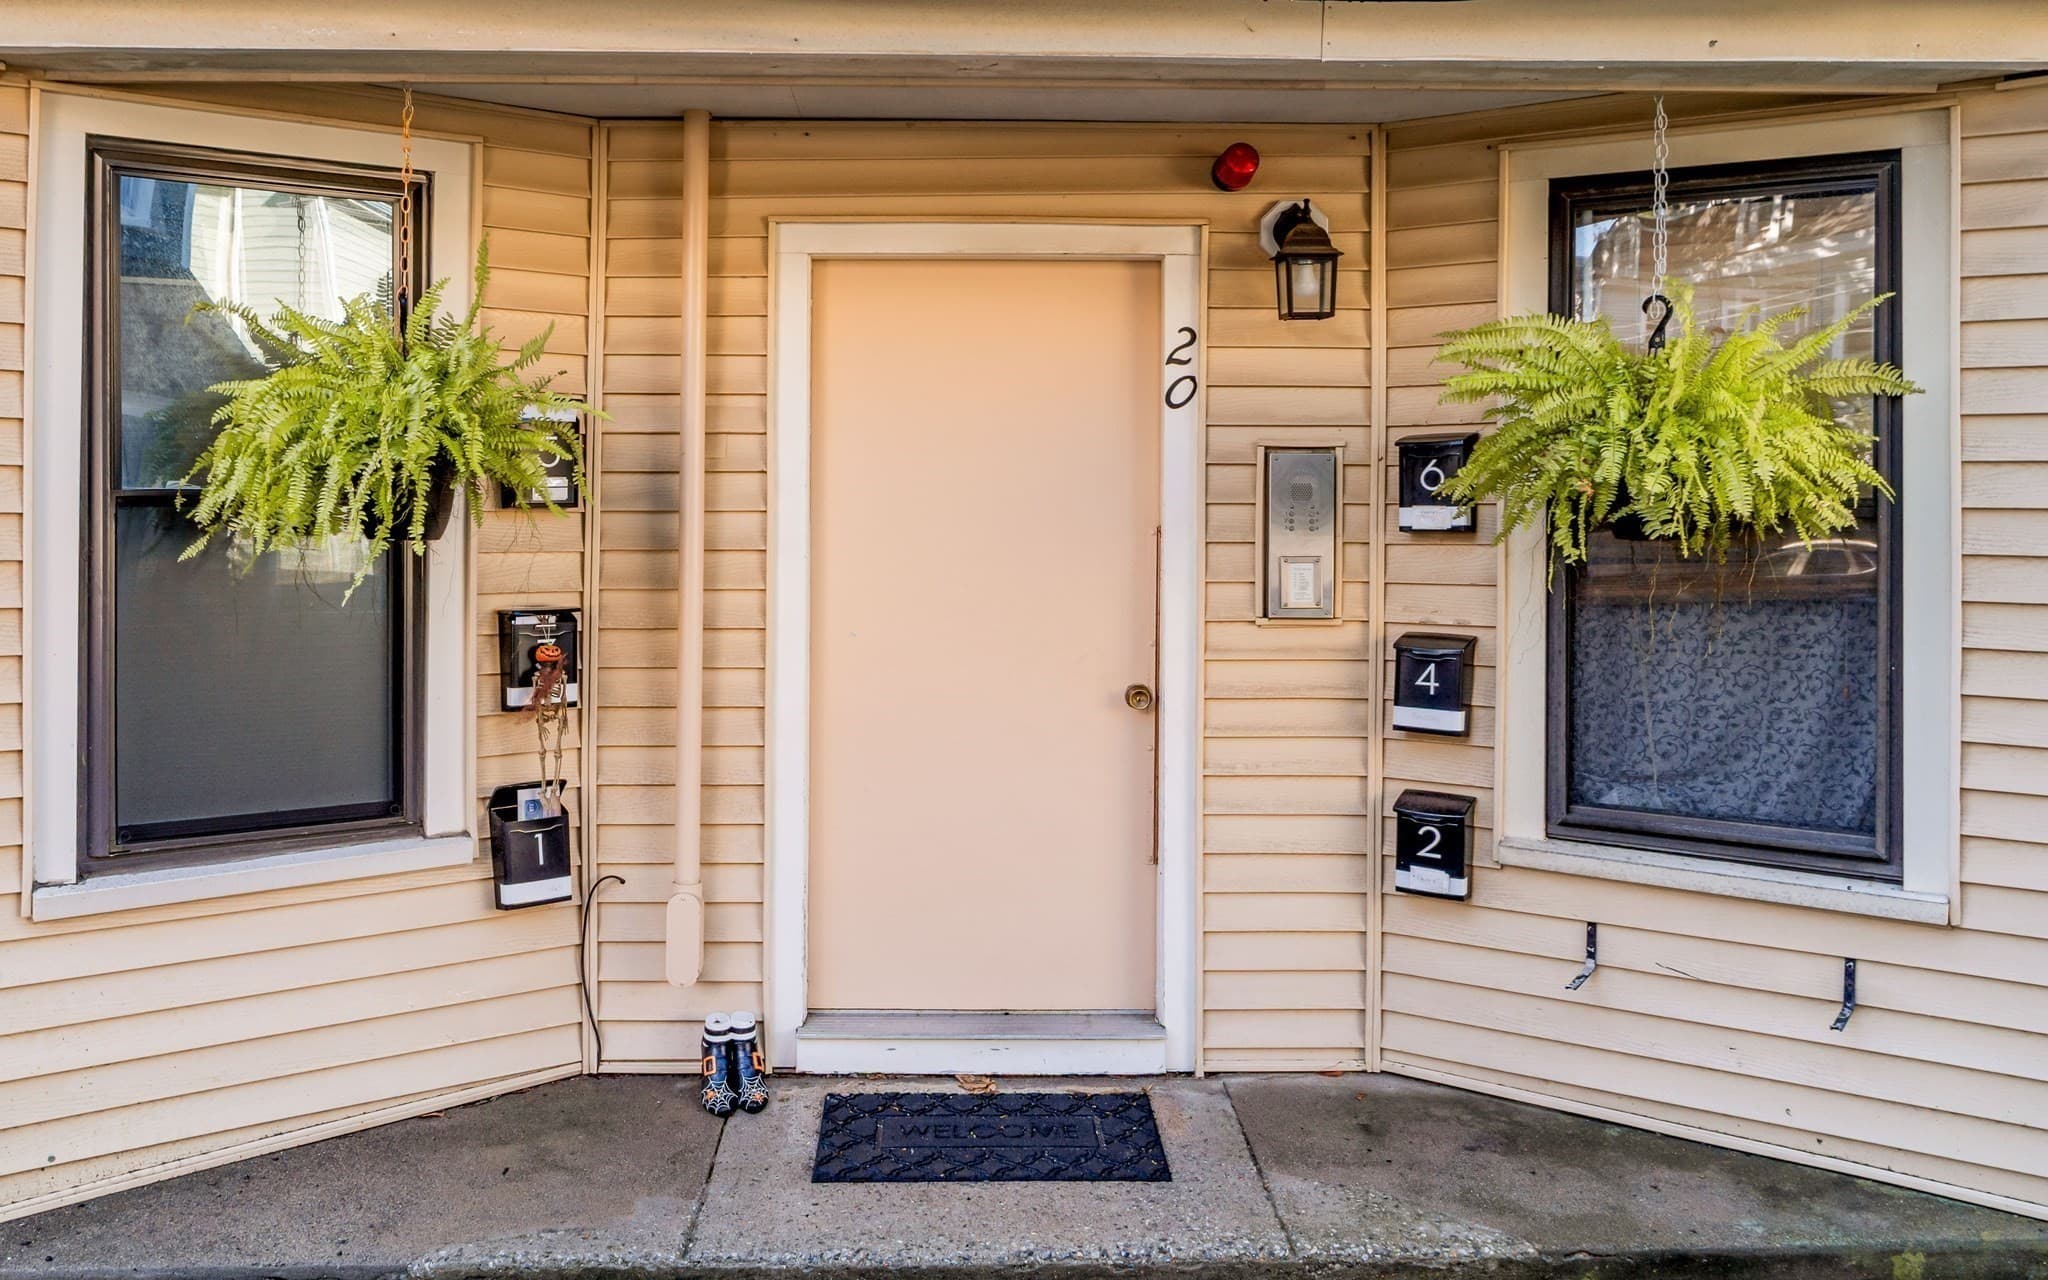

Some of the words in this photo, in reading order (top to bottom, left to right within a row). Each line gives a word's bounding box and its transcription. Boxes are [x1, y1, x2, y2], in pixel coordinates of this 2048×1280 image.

[1165, 326, 1198, 410] 20
[1420, 459, 1445, 491] 6
[1414, 662, 1440, 696] 4
[534, 832, 544, 866] 1
[1415, 825, 1442, 859] 2
[899, 1123, 1081, 1141] WELCOME
